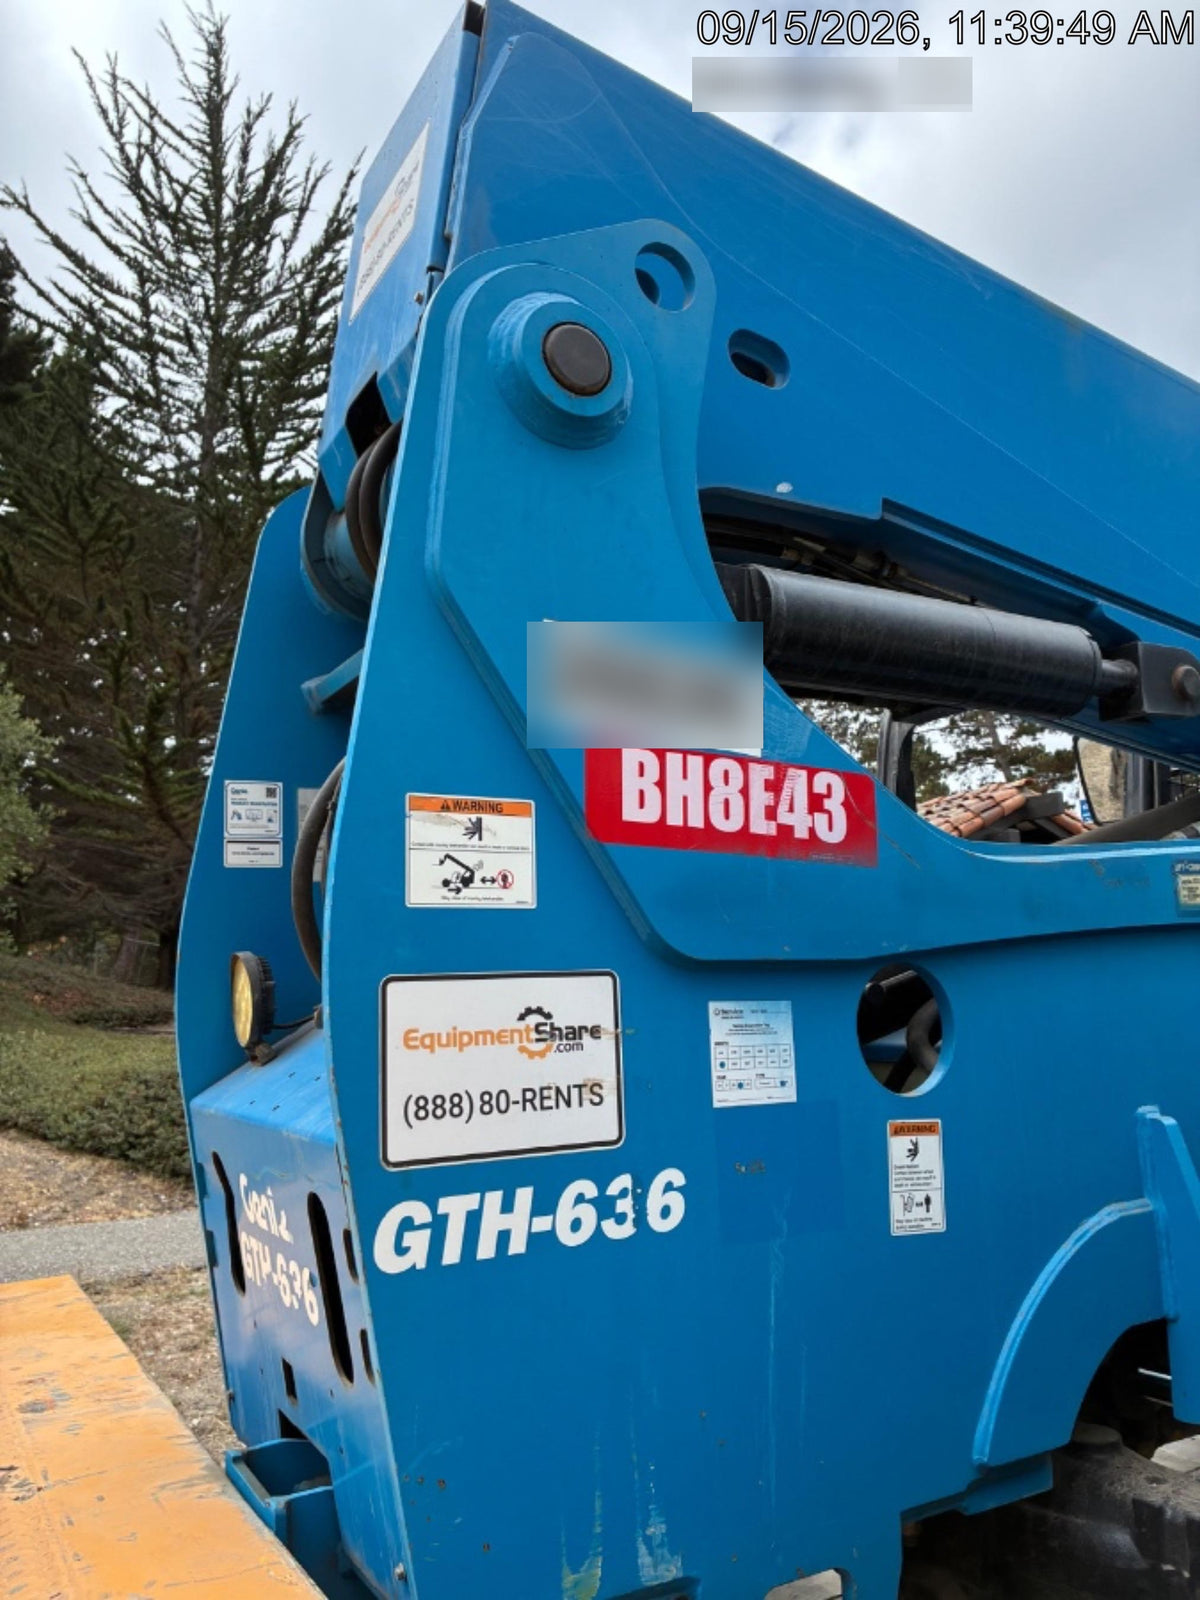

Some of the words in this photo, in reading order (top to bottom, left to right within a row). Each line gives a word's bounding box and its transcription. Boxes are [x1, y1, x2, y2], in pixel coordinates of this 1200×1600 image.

[453, 800, 504, 814] WARNING
[621, 748, 848, 844] BH8E43
[372, 1166, 687, 1275] GTH-636
[240, 1231, 320, 1327] GTH-636
